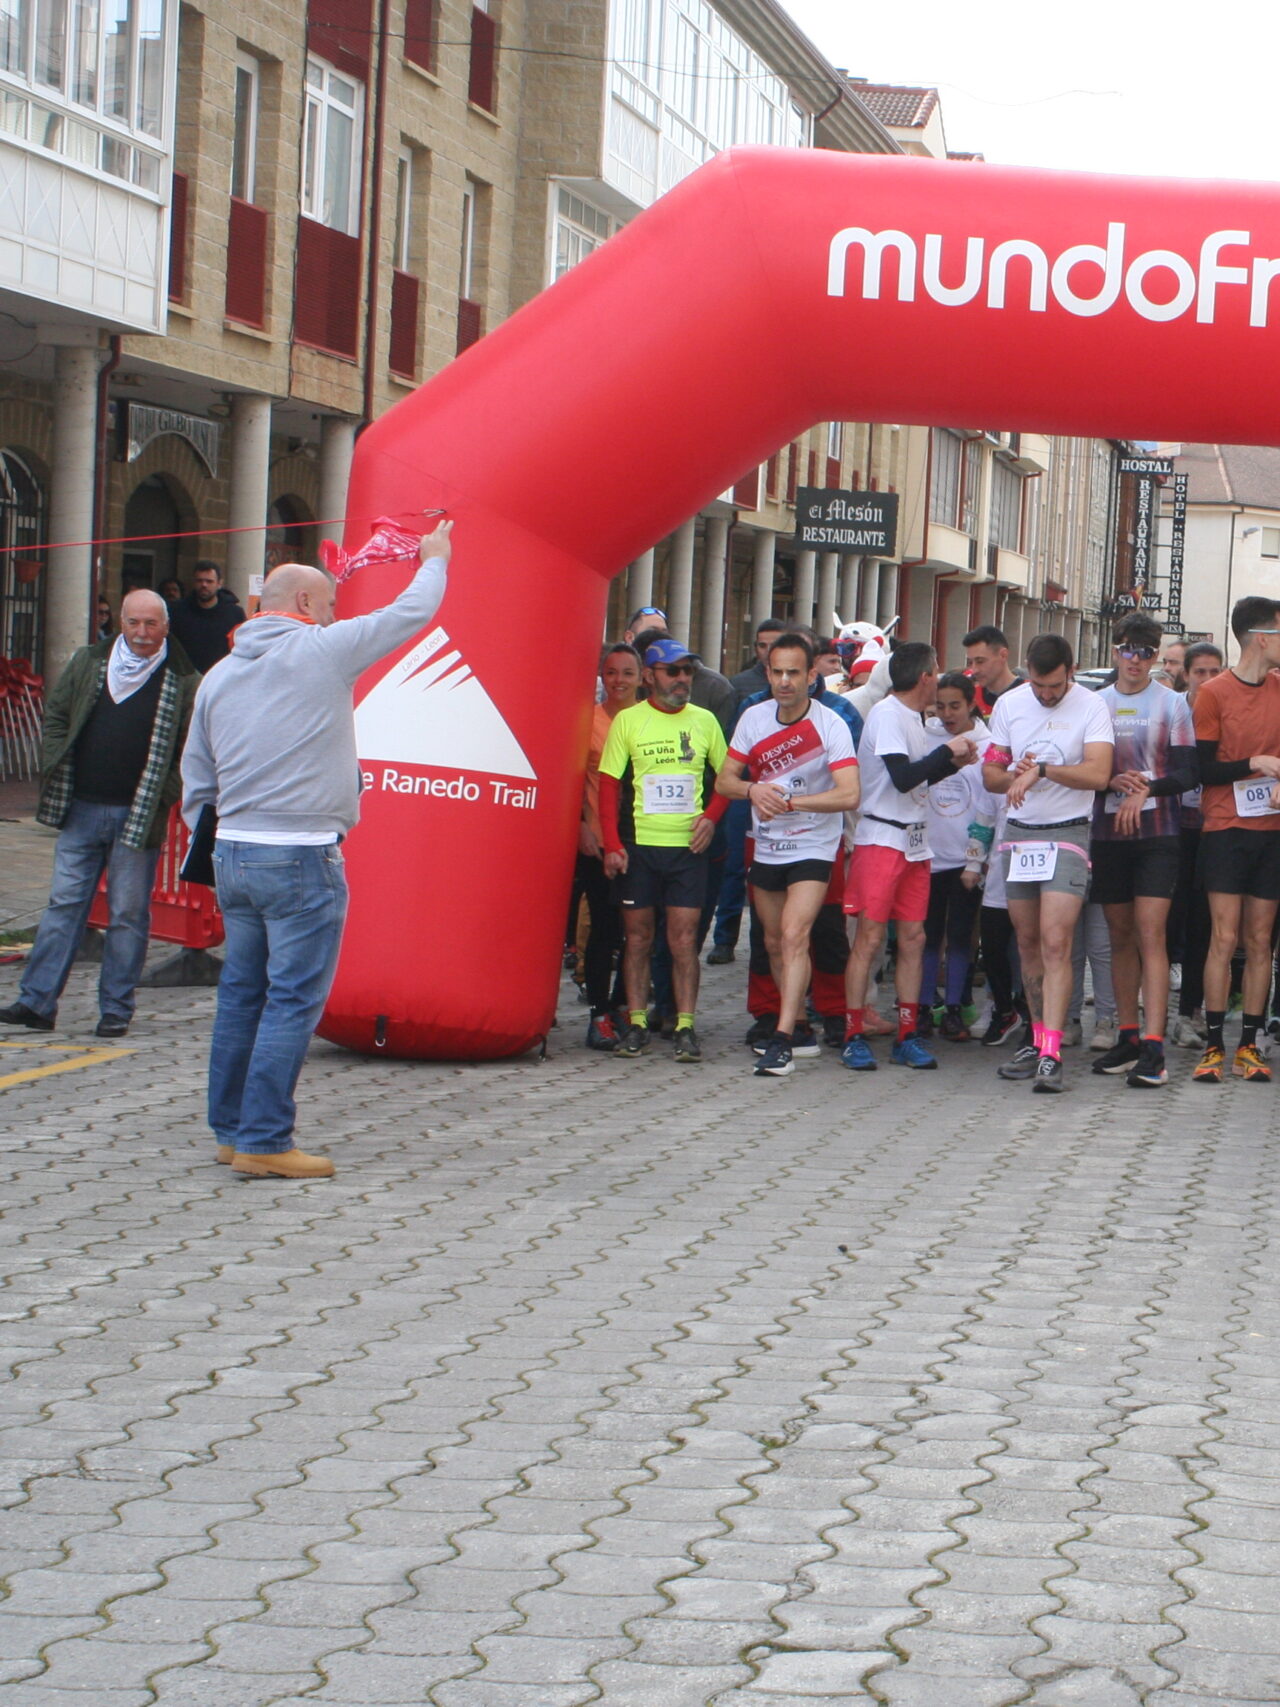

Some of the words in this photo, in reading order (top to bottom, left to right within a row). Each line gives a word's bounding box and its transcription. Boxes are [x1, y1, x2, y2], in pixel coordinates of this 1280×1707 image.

[1120, 459, 1171, 473] HOSTAL
[1174, 476, 1186, 519] HOTEL
[808, 505, 822, 519] El
[825, 499, 883, 522] Mesón
[802, 526, 886, 547] RESTAURANTE
[1134, 479, 1150, 587] RESTAURANTE
[1168, 531, 1182, 623] RESTAURANTE
[1118, 594, 1159, 609] SANZ
[656, 746, 675, 754] Uña
[655, 757, 676, 765] León
[381, 769, 480, 801] Ranedo
[489, 781, 537, 810] Trail
[656, 785, 685, 798] 132
[1246, 786, 1272, 801] 081
[909, 832, 923, 847] 054
[1020, 854, 1046, 867] 013
